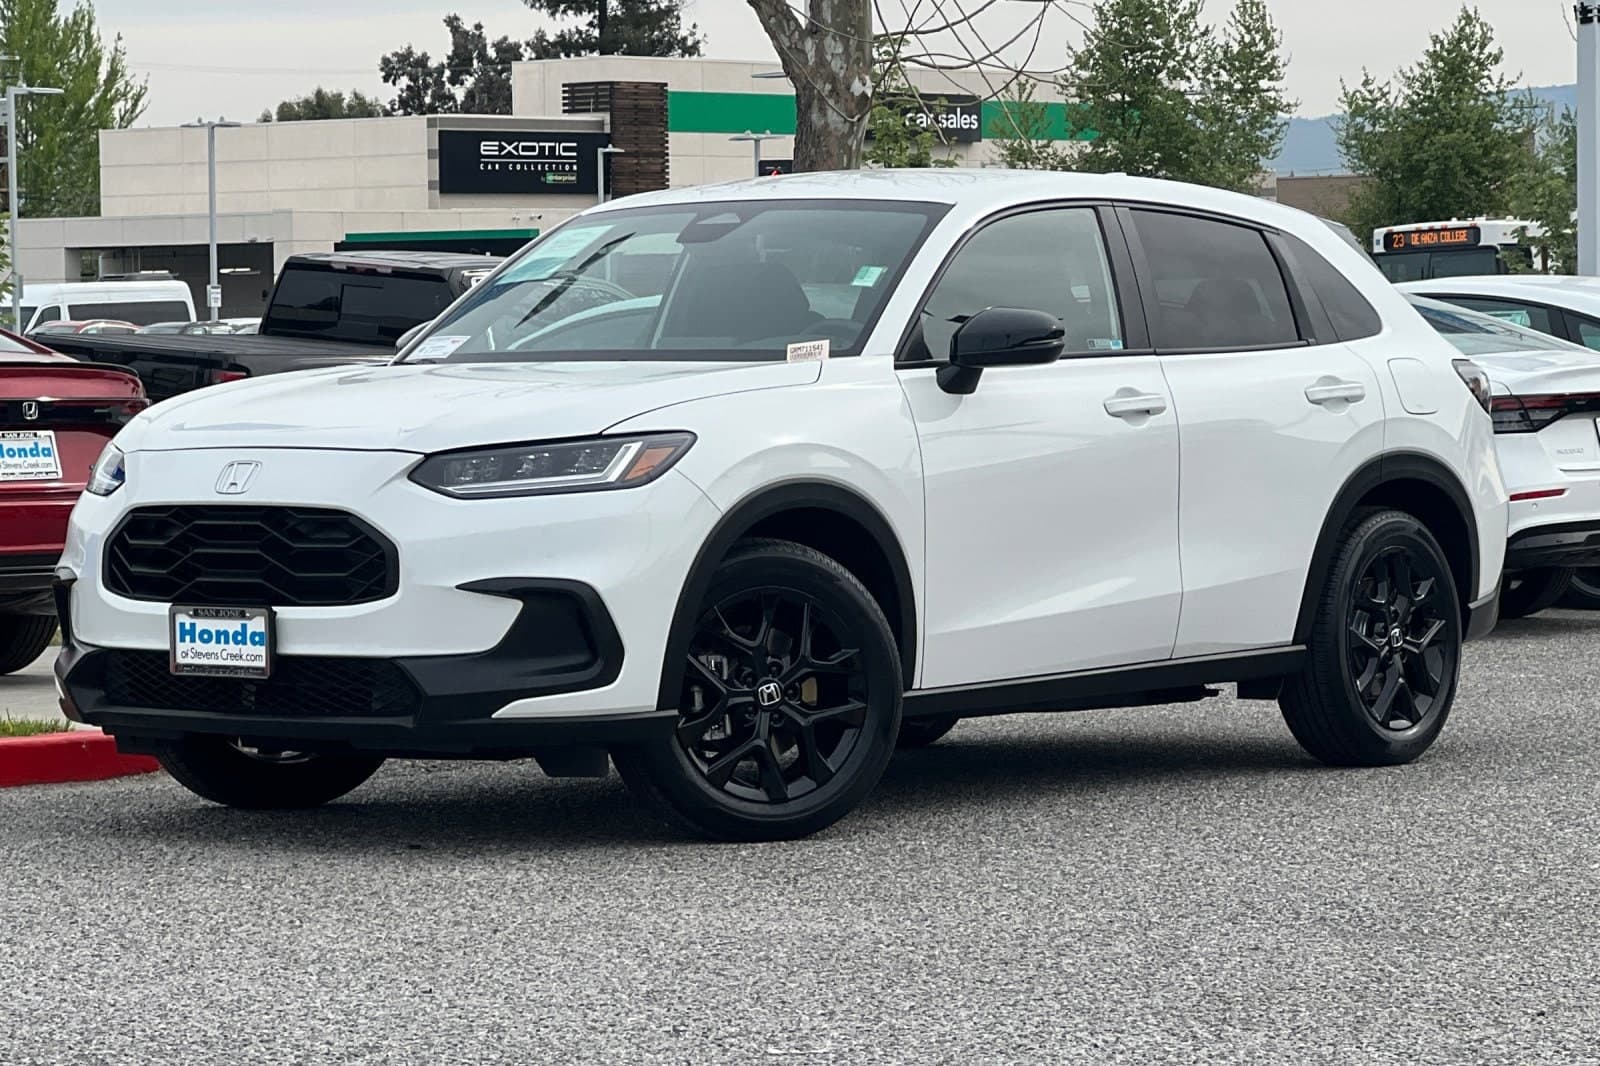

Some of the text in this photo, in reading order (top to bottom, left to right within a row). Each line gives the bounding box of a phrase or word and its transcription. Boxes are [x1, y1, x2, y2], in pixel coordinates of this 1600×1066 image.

[904, 112, 934, 128] car
[938, 107, 978, 129] sales
[480, 141, 577, 156] EXOTIC
[508, 163, 577, 171] COLLECTION
[1392, 229, 1468, 248] 23 DE ANZA COLLEGE
[198, 608, 217, 617] SAN
[179, 622, 265, 646] Honda
[180, 650, 189, 659] of
